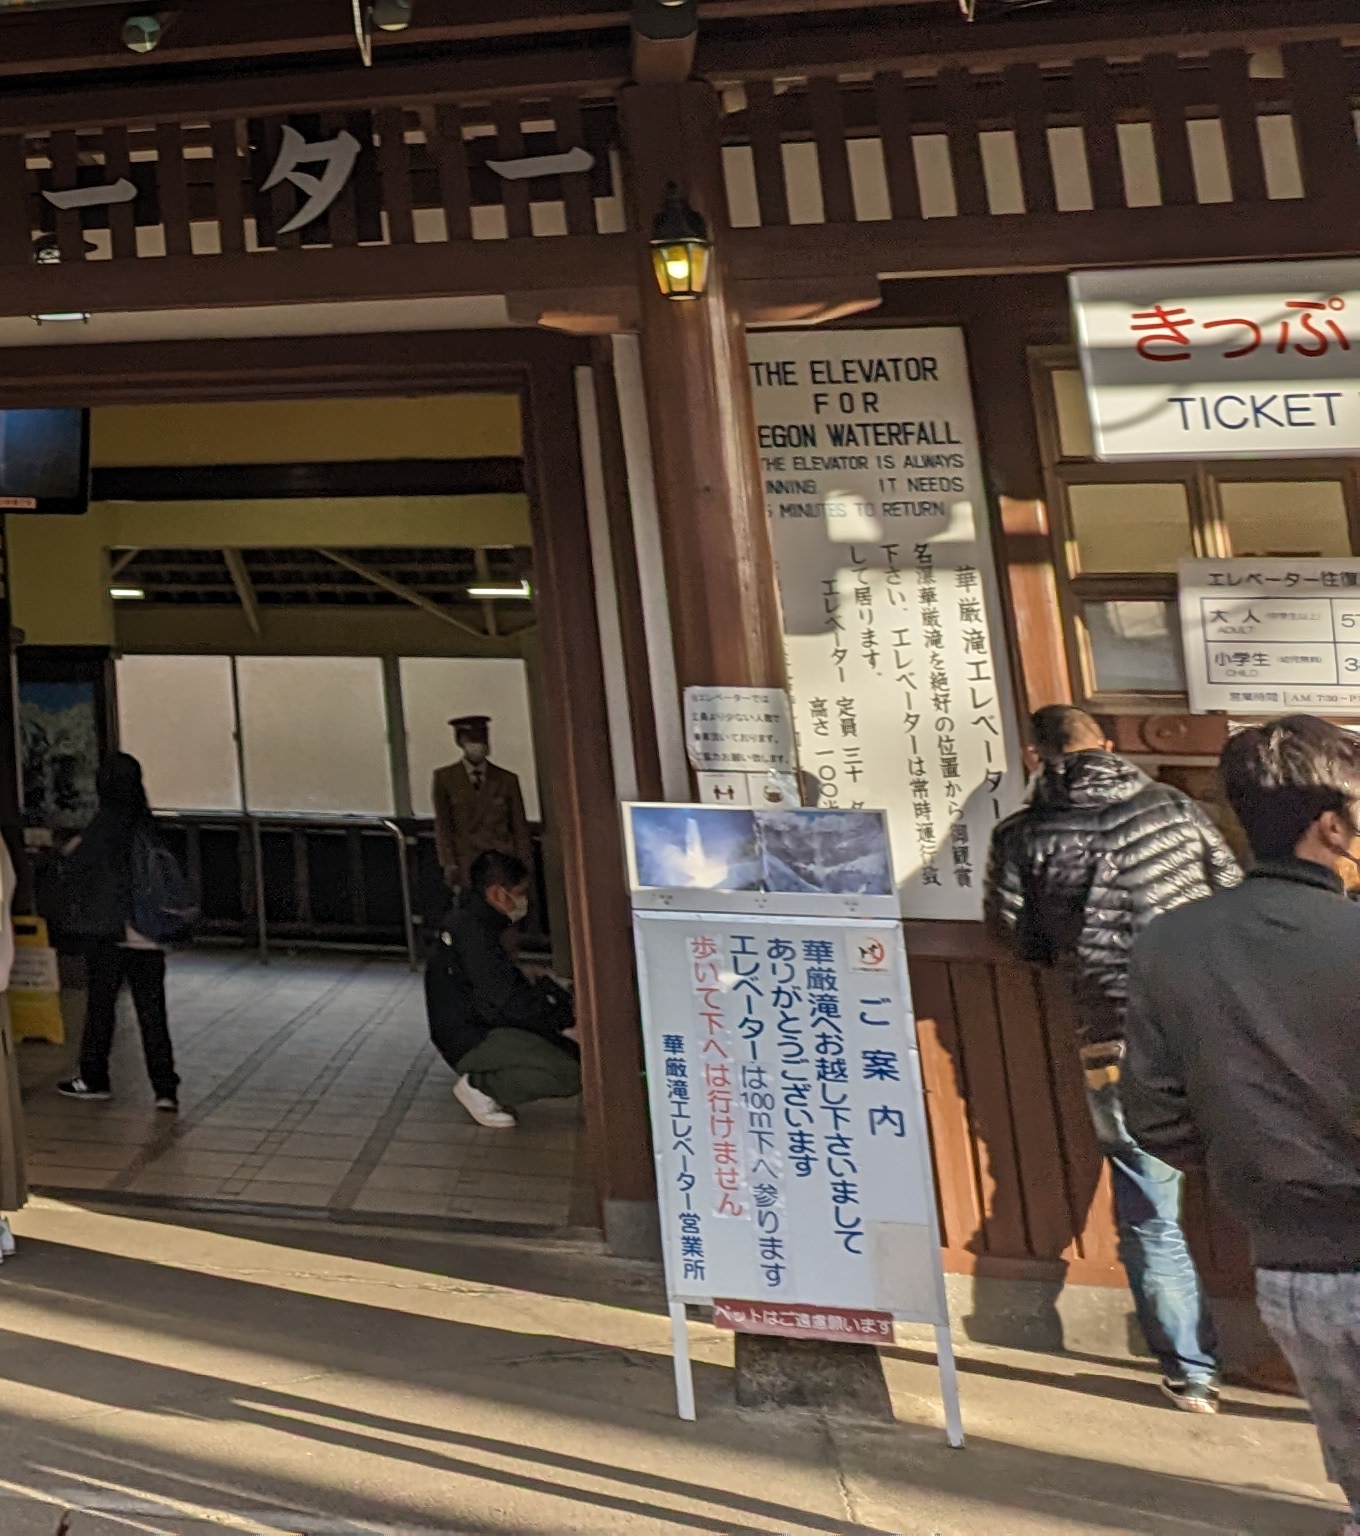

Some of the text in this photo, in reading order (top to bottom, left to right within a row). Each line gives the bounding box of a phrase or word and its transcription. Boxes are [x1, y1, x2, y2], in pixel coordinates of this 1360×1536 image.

[1130, 295, 1351, 362] きっぷ
[747, 357, 939, 386] THE ELEVATOR
[813, 391, 880, 415] FOR
[1167, 392, 1342, 430] TICKET
[757, 421, 961, 449] EGON WATERFALL
[766, 477, 965, 495] NNING IT NEEDS
[793, 455, 870, 471] ELEVATOR
[877, 455, 896, 470] IS
[903, 454, 965, 469] ALWAYS
[780, 502, 847, 518] MINUTES
[856, 502, 876, 518] TO
[883, 501, 946, 517] RETURN
[820, 578, 846, 683] エレベーター
[1215, 652, 1271, 667] 小学生
[953, 565, 1002, 819] 華厳滝エレベーター
[690, 935, 744, 1217] 歩いて下へは行けません
[767, 937, 820, 1178] ありがとうございます
[859, 997, 906, 1138] ご案内
[802, 939, 865, 1255] 華厳滝へお越し下さいまして
[661, 1034, 706, 1282] 華厳滝エレベーター営業所
